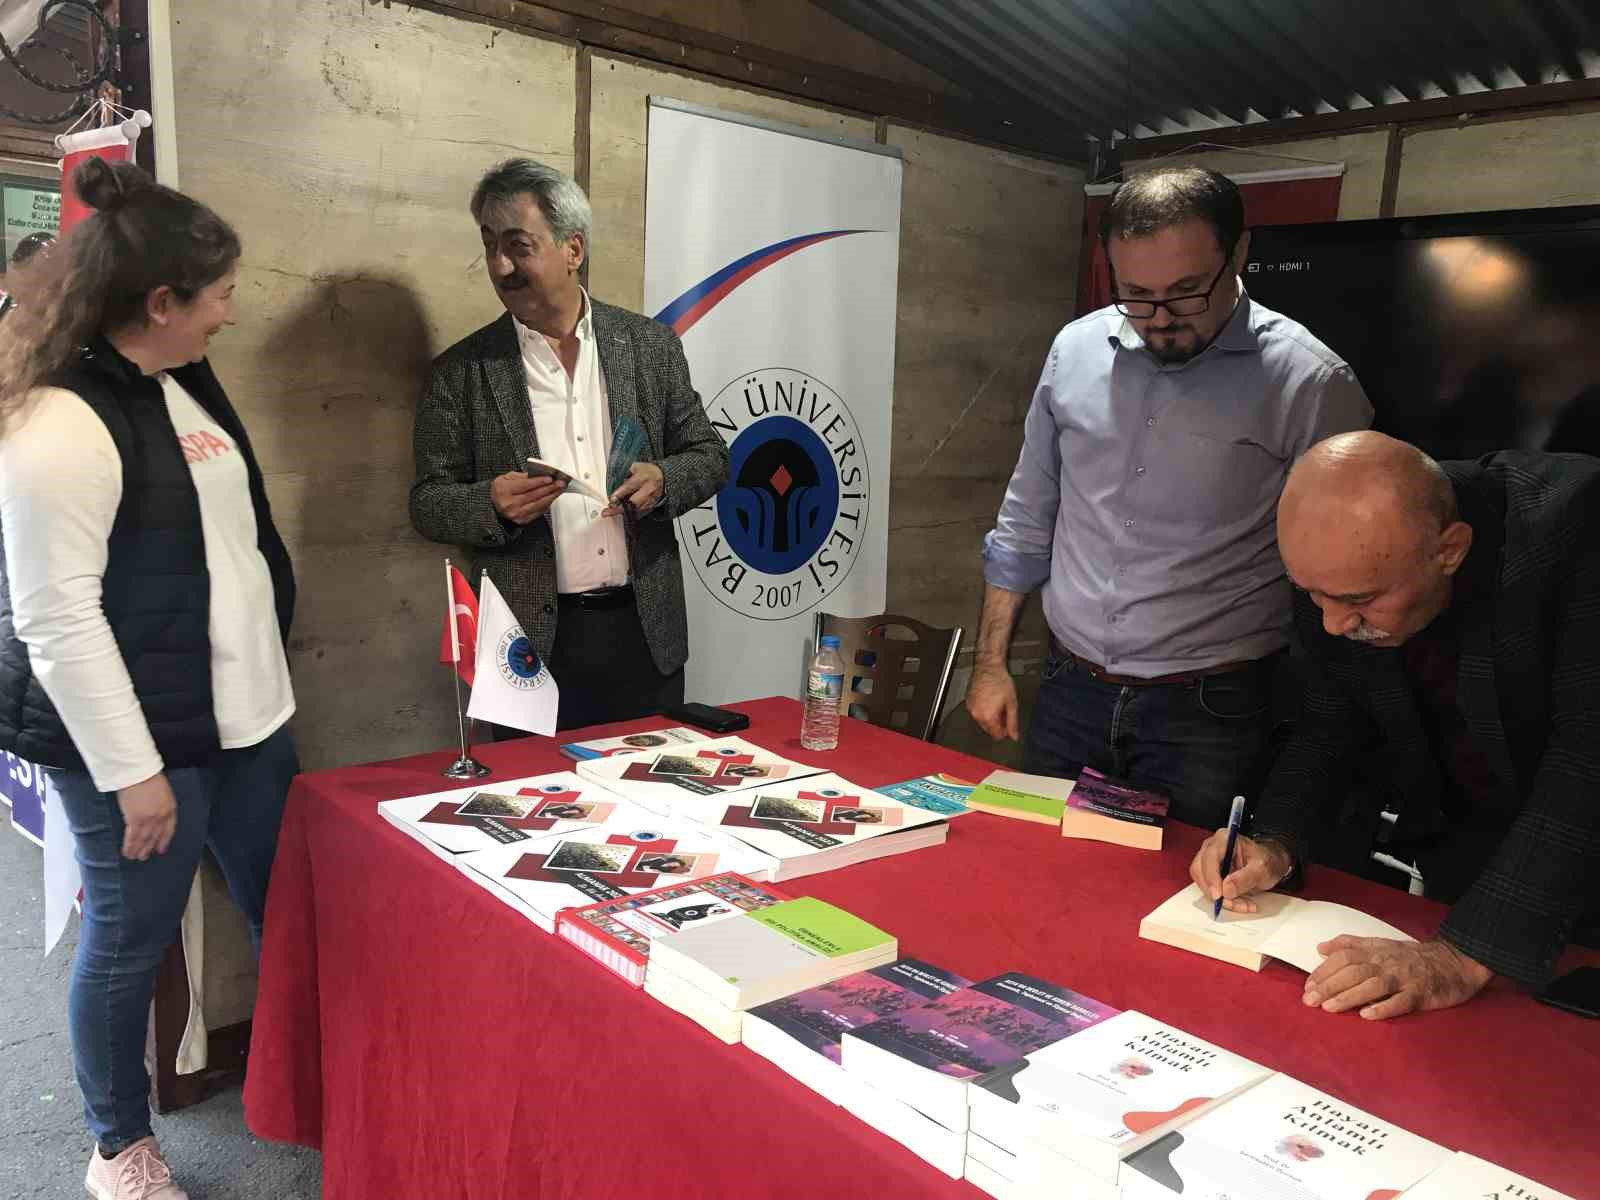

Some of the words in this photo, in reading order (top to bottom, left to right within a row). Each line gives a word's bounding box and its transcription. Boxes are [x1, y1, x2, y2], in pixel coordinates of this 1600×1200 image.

[1279, 261, 1303, 272] HDMI
[689, 407, 748, 595] BATN
[743, 377, 867, 594] ÜNİVERSİTESİ
[751, 580, 802, 609] 2007
[1124, 1041, 1192, 1073] Kılmak
[1134, 1035, 1211, 1068] Anlamlı
[1155, 1030, 1217, 1059] Hayatı
[1283, 1113, 1366, 1156] Kılmak
[1290, 1105, 1385, 1150] Anlamlı
[1312, 1100, 1389, 1139] Hayatı
